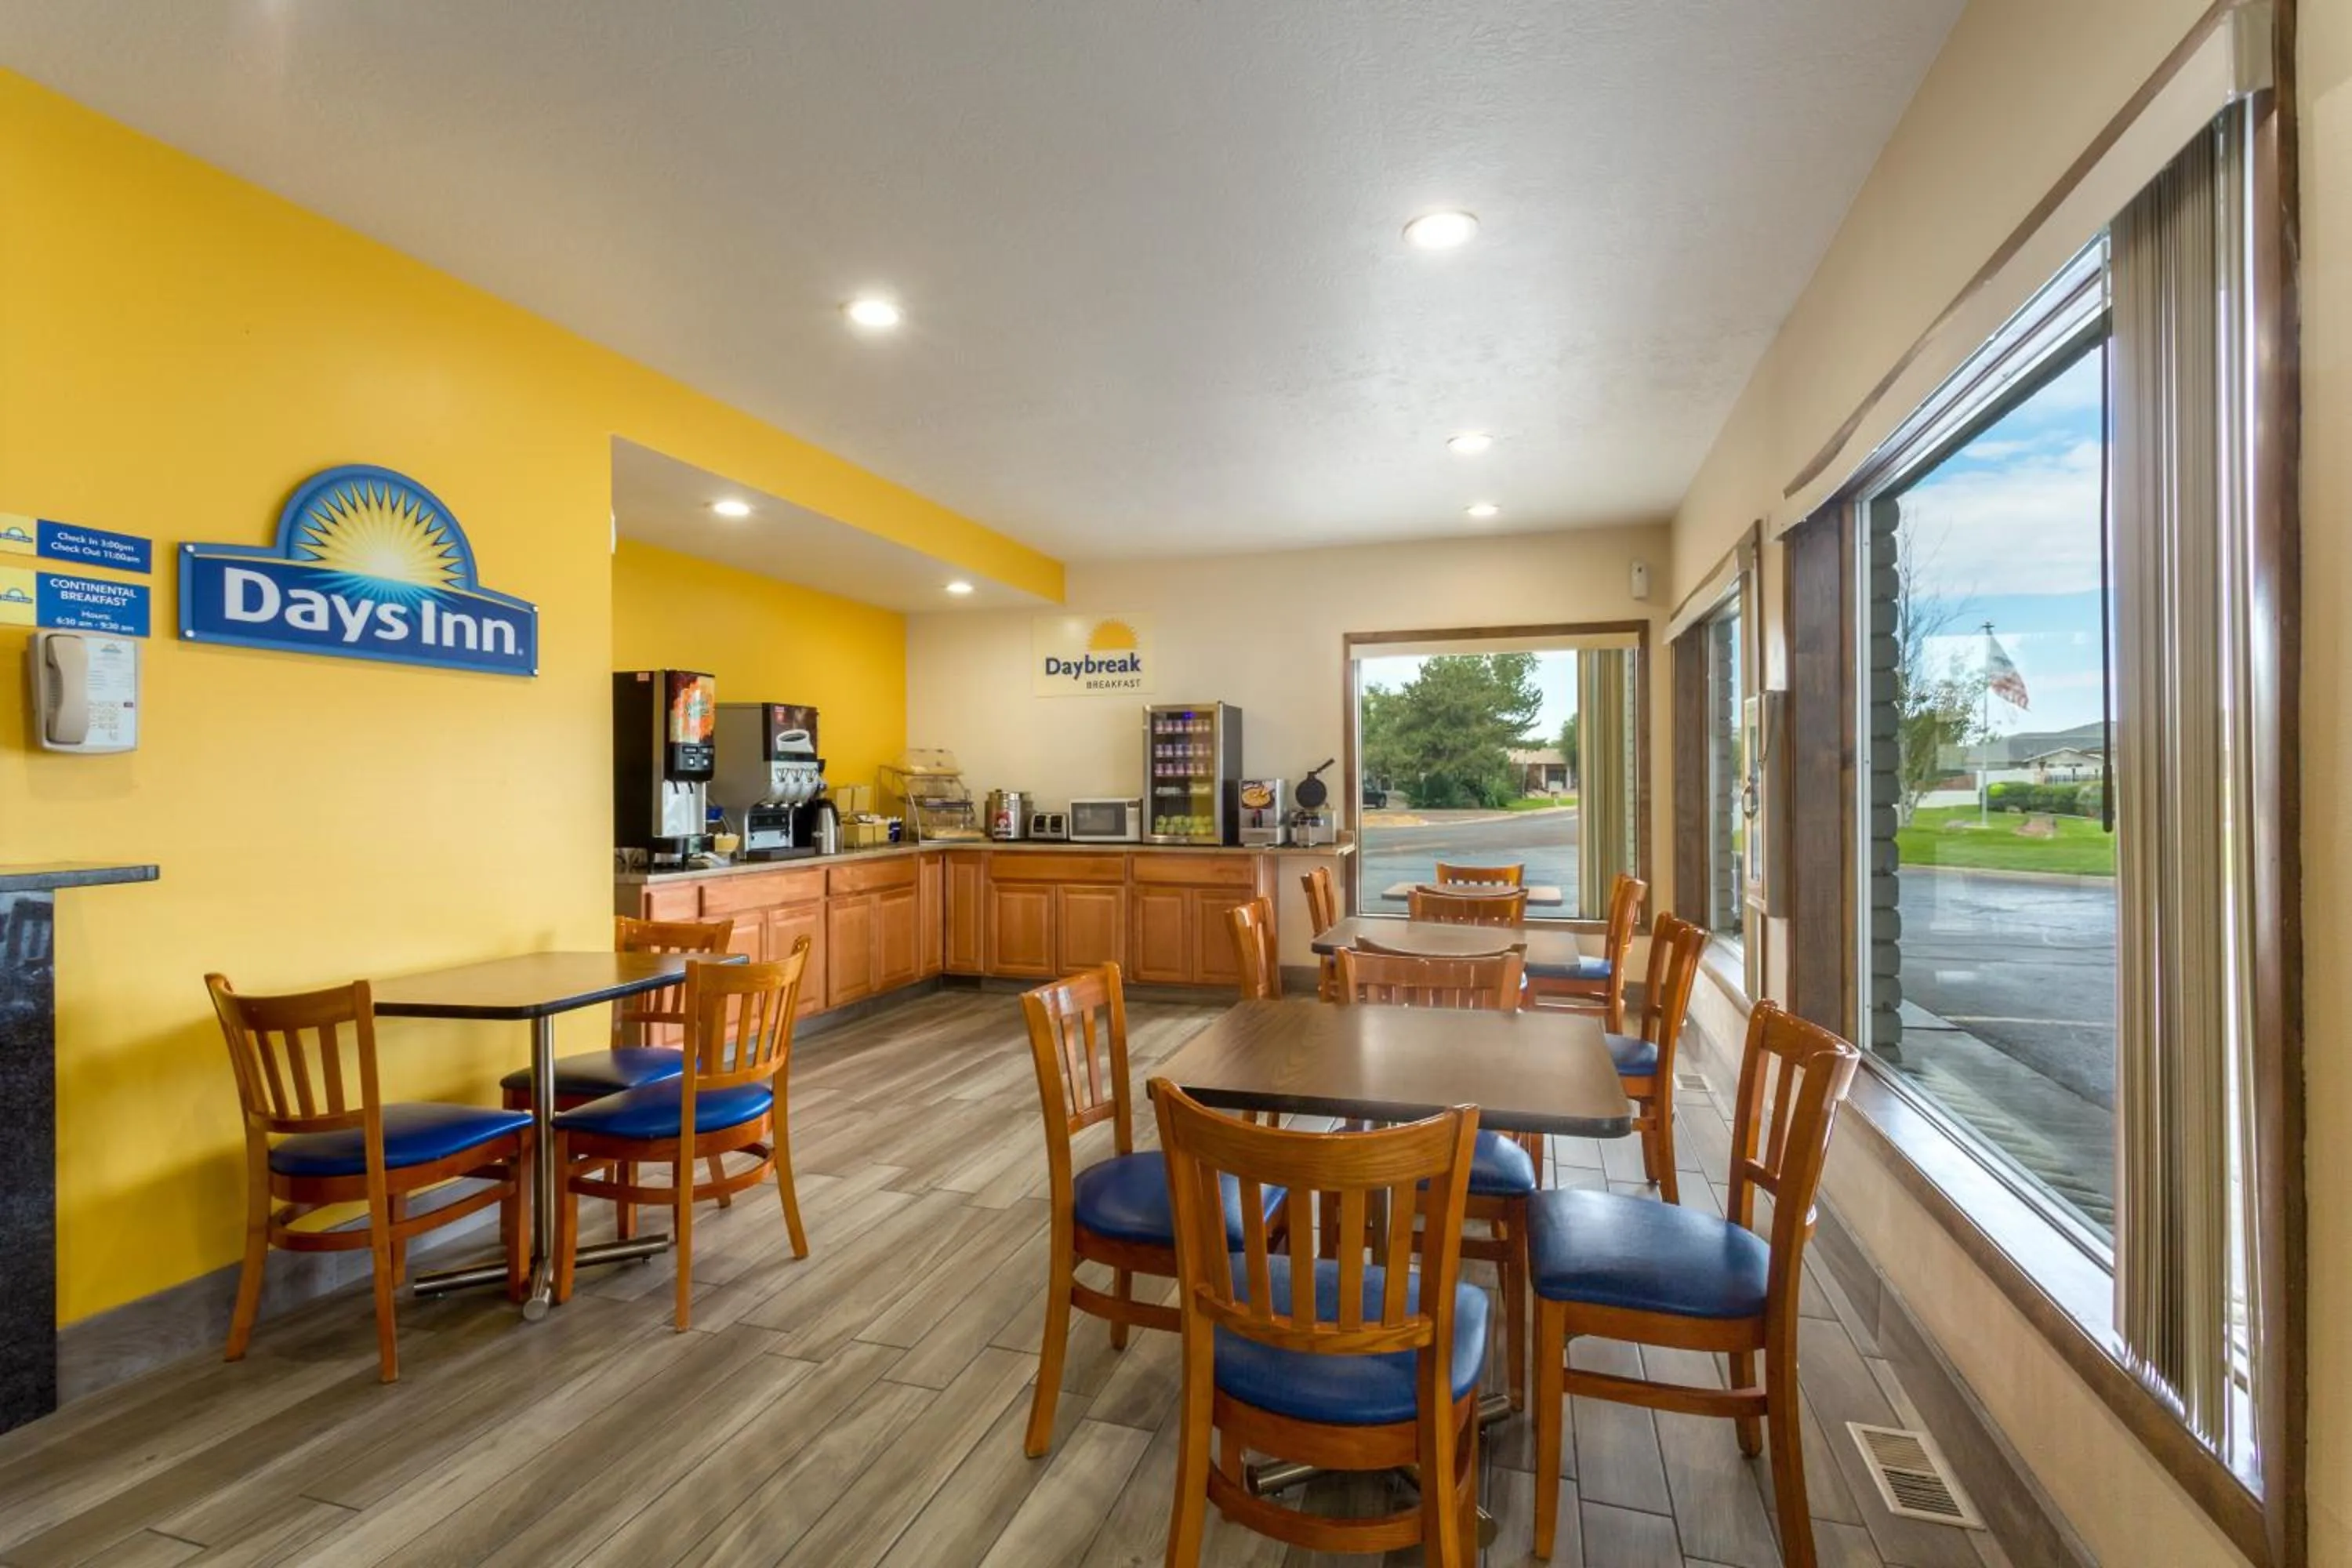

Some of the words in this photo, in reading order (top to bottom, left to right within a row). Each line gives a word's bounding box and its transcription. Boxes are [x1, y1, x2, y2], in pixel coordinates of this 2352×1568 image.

[50, 541, 80, 555] Check
[82, 546, 101, 557] Out
[103, 550, 141, 564] 11:00am
[57, 532, 86, 544] Check
[89, 537, 99, 546] In
[101, 539, 134, 553] 3:00pm
[49, 577, 137, 598] CONTINENTAL
[60, 590, 129, 607] BREAKFAST
[56, 616, 76, 626] 6:30
[81, 611, 111, 621] Hours:
[224, 567, 409, 643] Days
[421, 600, 516, 655] Inn
[1045, 652, 1142, 681] Daybreak
[1086, 679, 1142, 689] BREAKFAST
